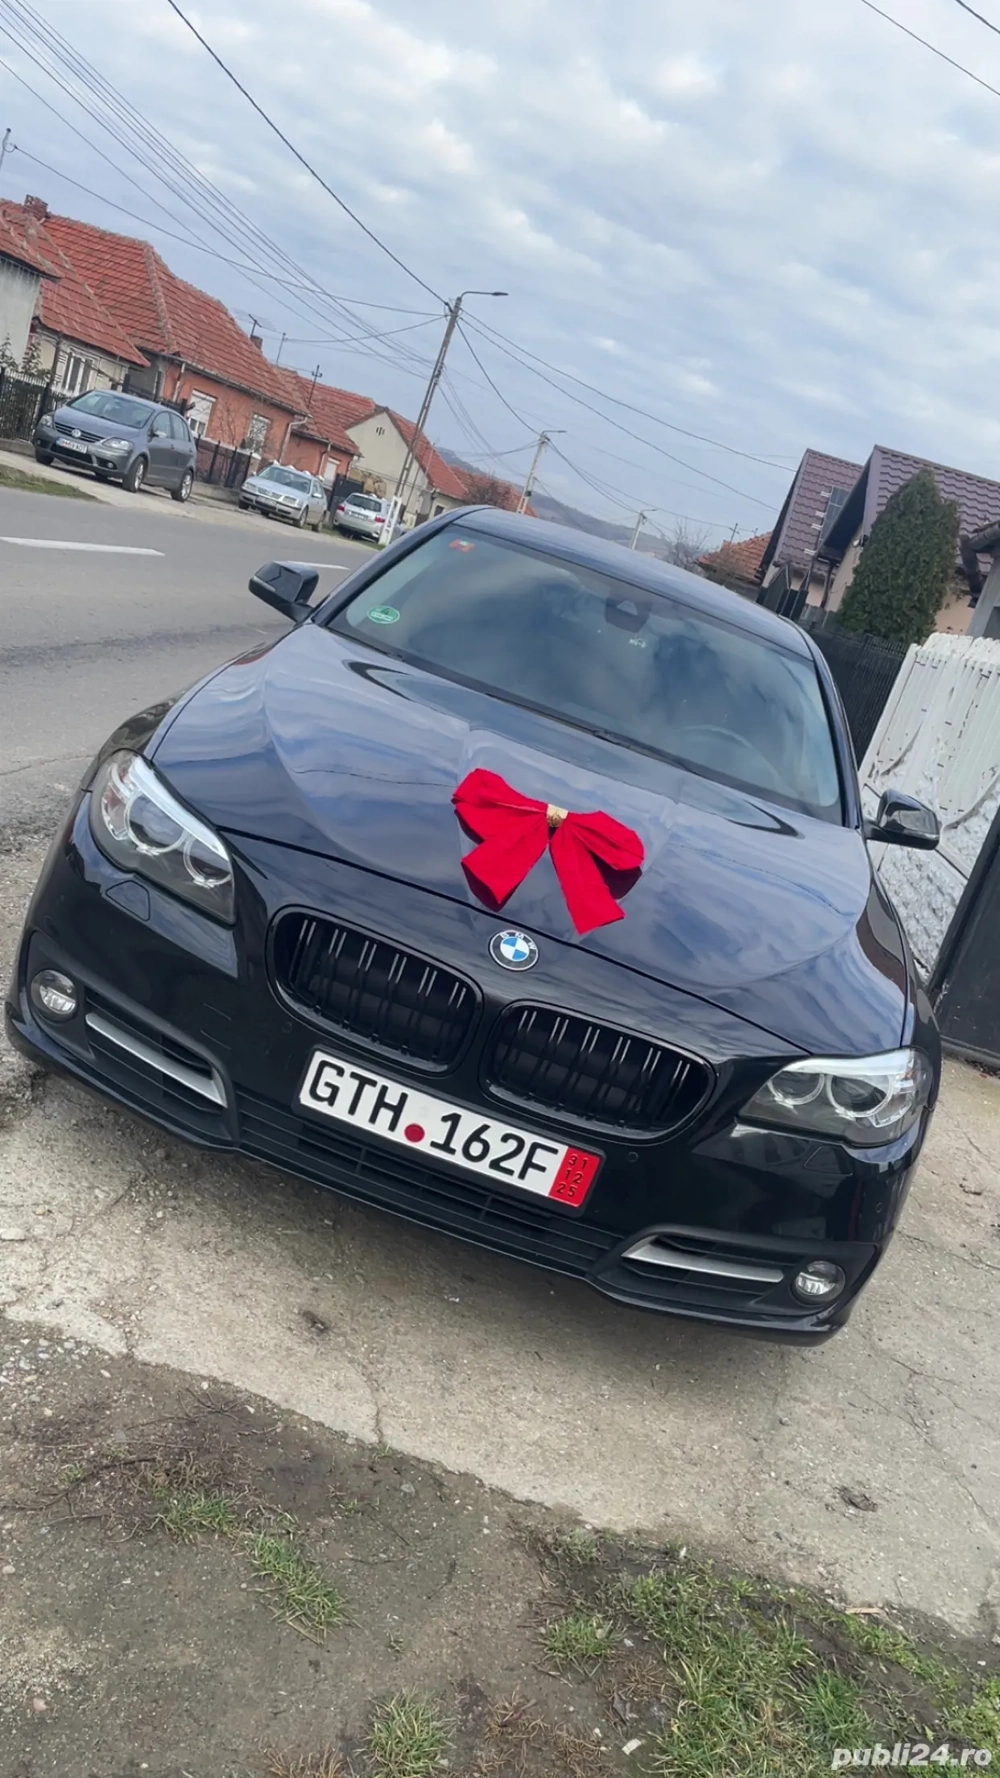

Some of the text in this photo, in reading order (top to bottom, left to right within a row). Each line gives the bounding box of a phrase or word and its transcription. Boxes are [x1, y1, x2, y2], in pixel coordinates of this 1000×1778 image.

[499, 931, 537, 950] BMW
[308, 1059, 559, 1181] GTH 162F
[568, 1153, 589, 1170] 31
[565, 1168, 584, 1185] 12
[556, 1182, 578, 1198] 25
